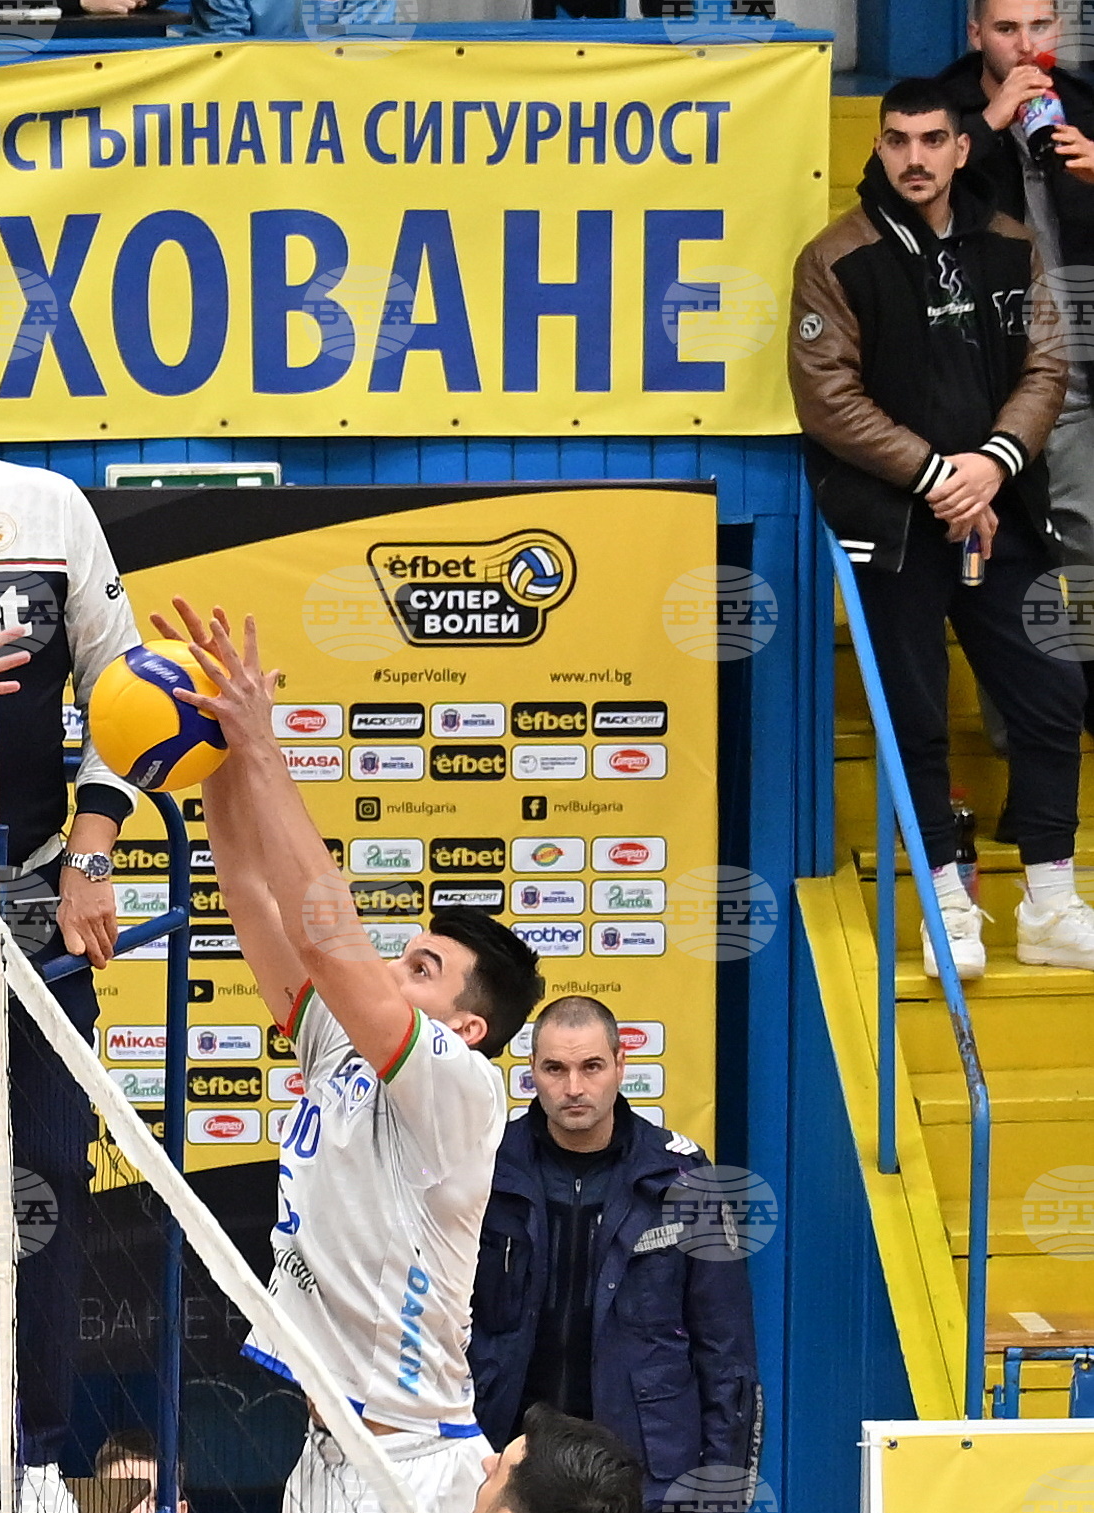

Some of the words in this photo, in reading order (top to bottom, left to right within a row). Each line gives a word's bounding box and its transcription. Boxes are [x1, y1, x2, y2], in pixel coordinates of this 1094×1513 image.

[363, 100, 730, 166] СИГУРНОСТ
[410, 589, 500, 610] СУПЕР
[424, 607, 520, 634] ВОЛЕЙ
[373, 668, 467, 685] #SuperVolley
[549, 668, 633, 686] www.nvl.bg
[386, 800, 457, 816] nvlBulgaria
[554, 800, 624, 815] nvlBulgaria
[113, 849, 169, 869] efbe
[551, 980, 622, 995] nvlBulgaria
[282, 1096, 321, 1160] 10
[395, 1264, 431, 1397] DAIKIN
